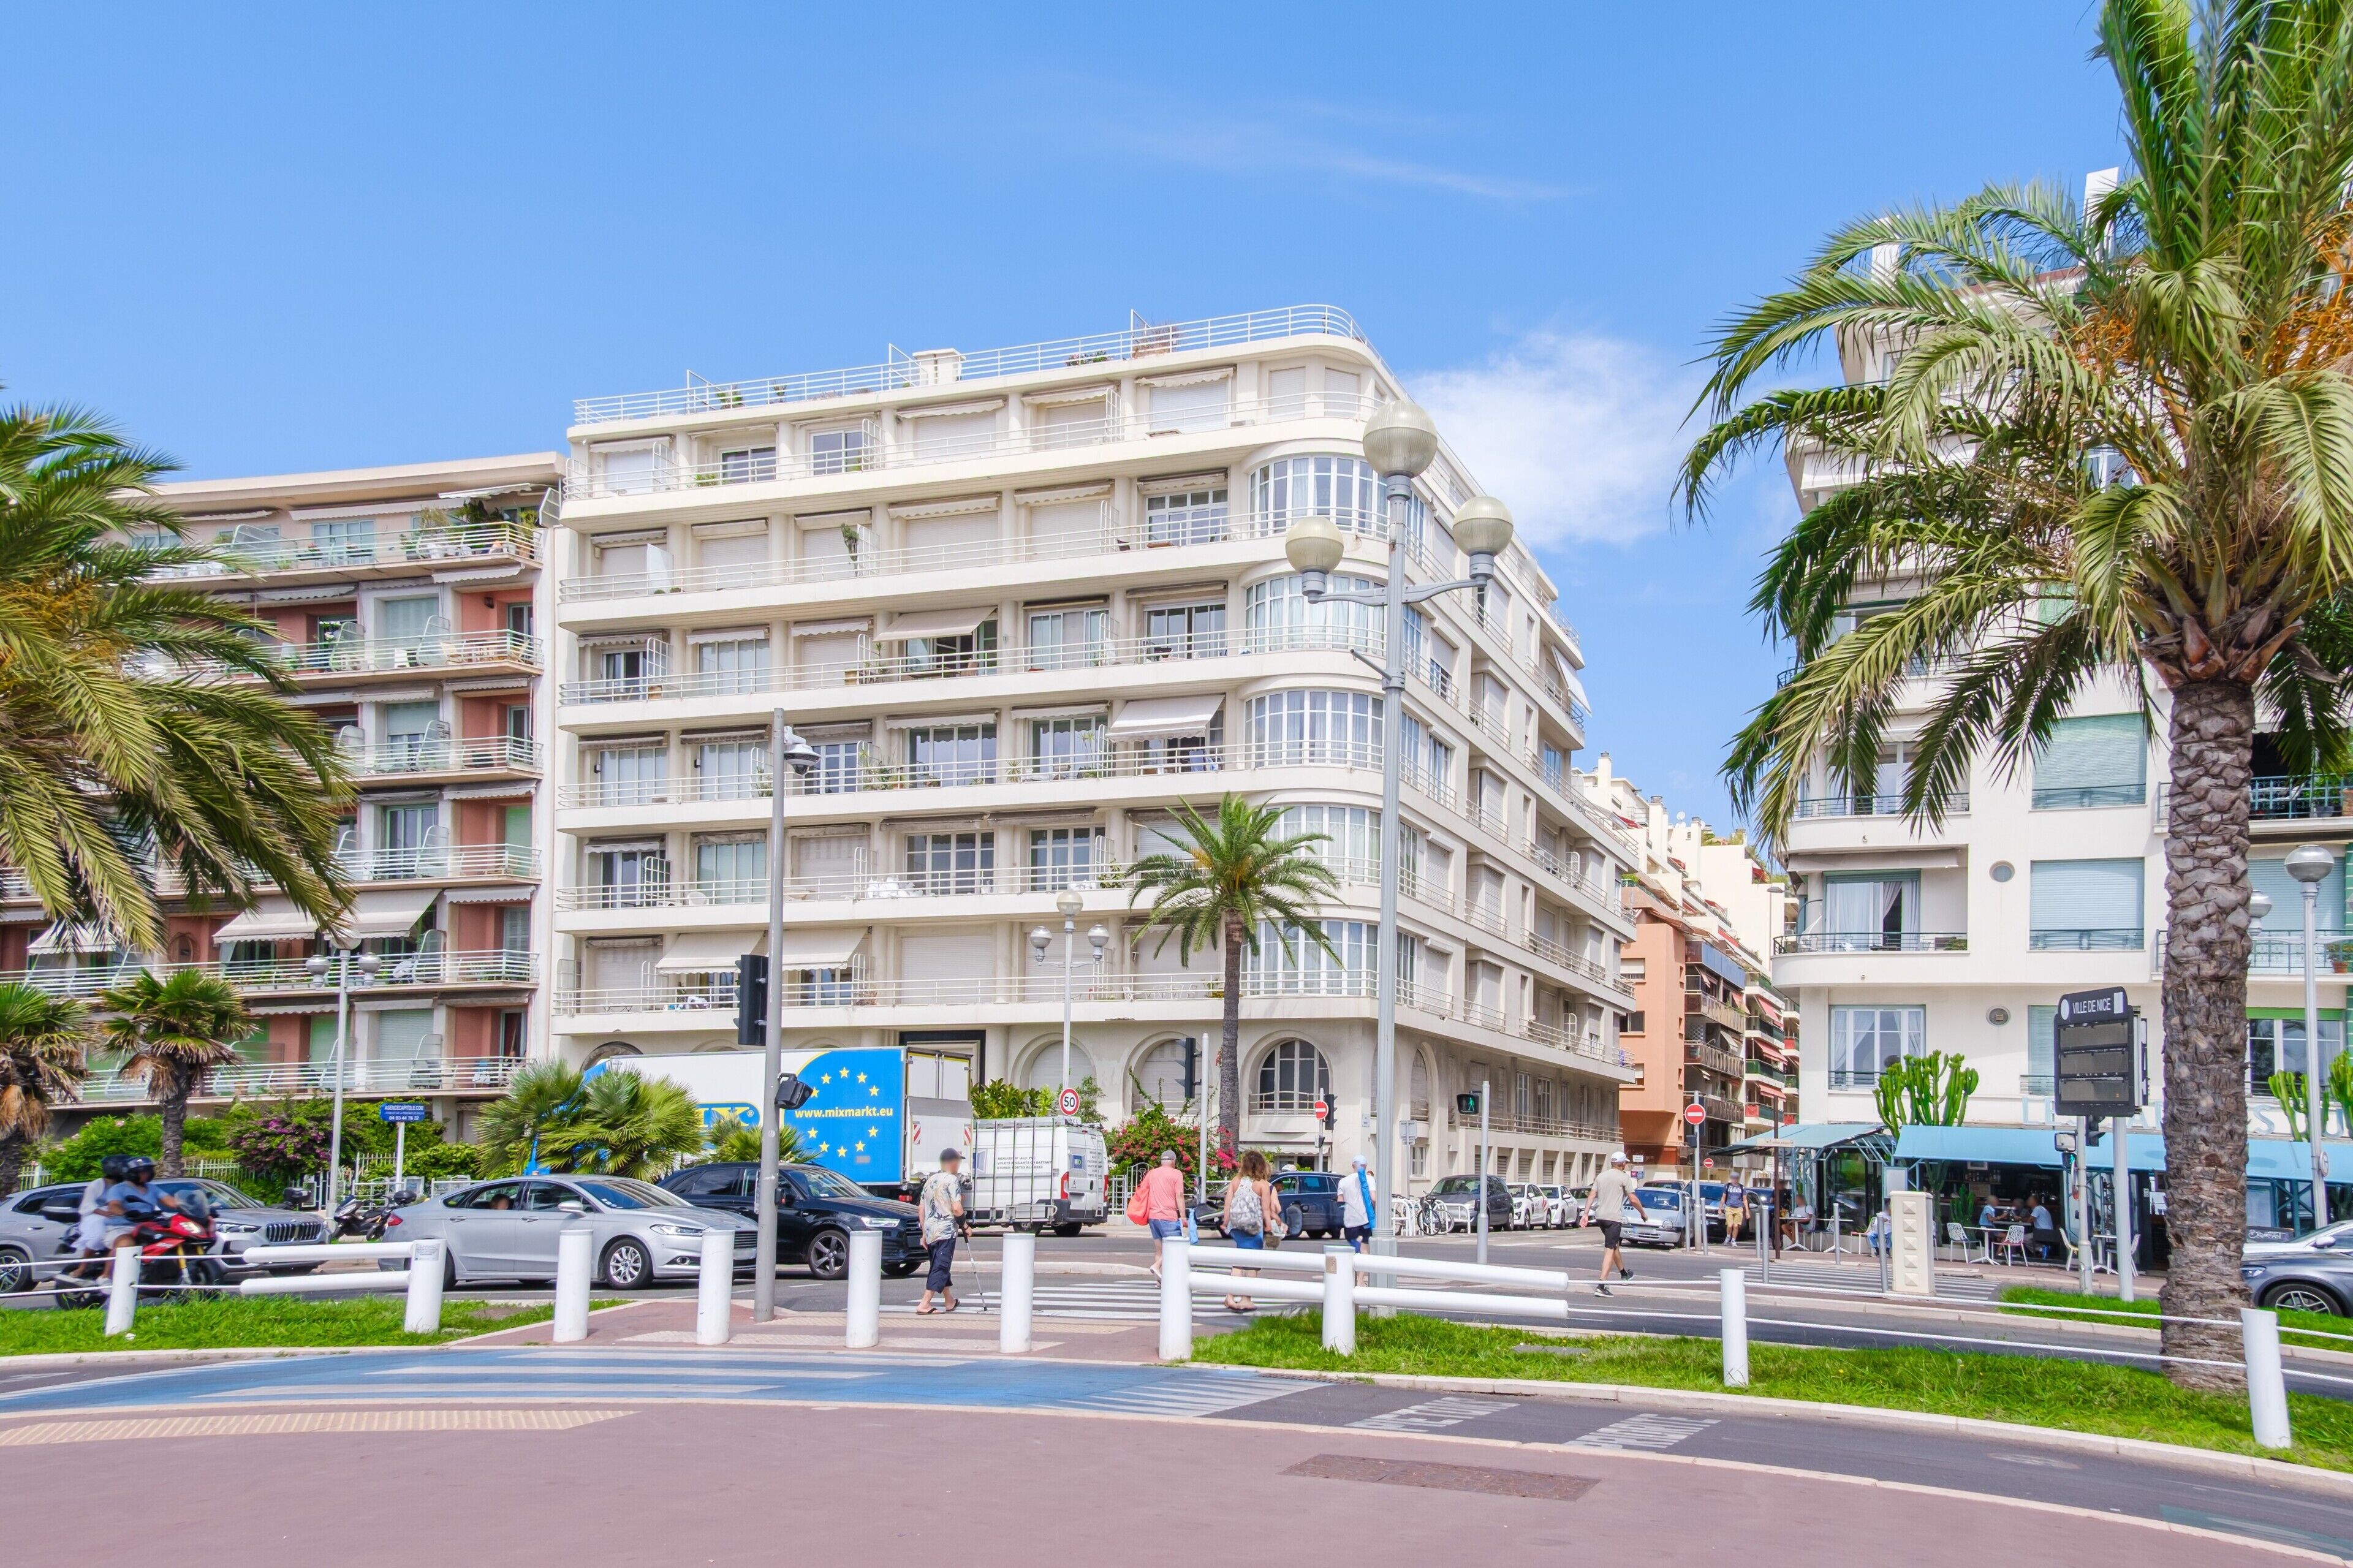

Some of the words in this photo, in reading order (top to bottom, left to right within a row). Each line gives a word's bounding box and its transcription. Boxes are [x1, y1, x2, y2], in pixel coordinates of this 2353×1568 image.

[2072, 1001, 2087, 1014] VILLE
[2088, 1000, 2096, 1012] DE
[2097, 998, 2111, 1011] NICE
[1064, 1096, 1075, 1107] 50
[795, 1105, 893, 1118] www.mixmarkt.eu
[1343, 1396, 1521, 1433] PIETONS
[1561, 1413, 1722, 1453] PRIORITE
